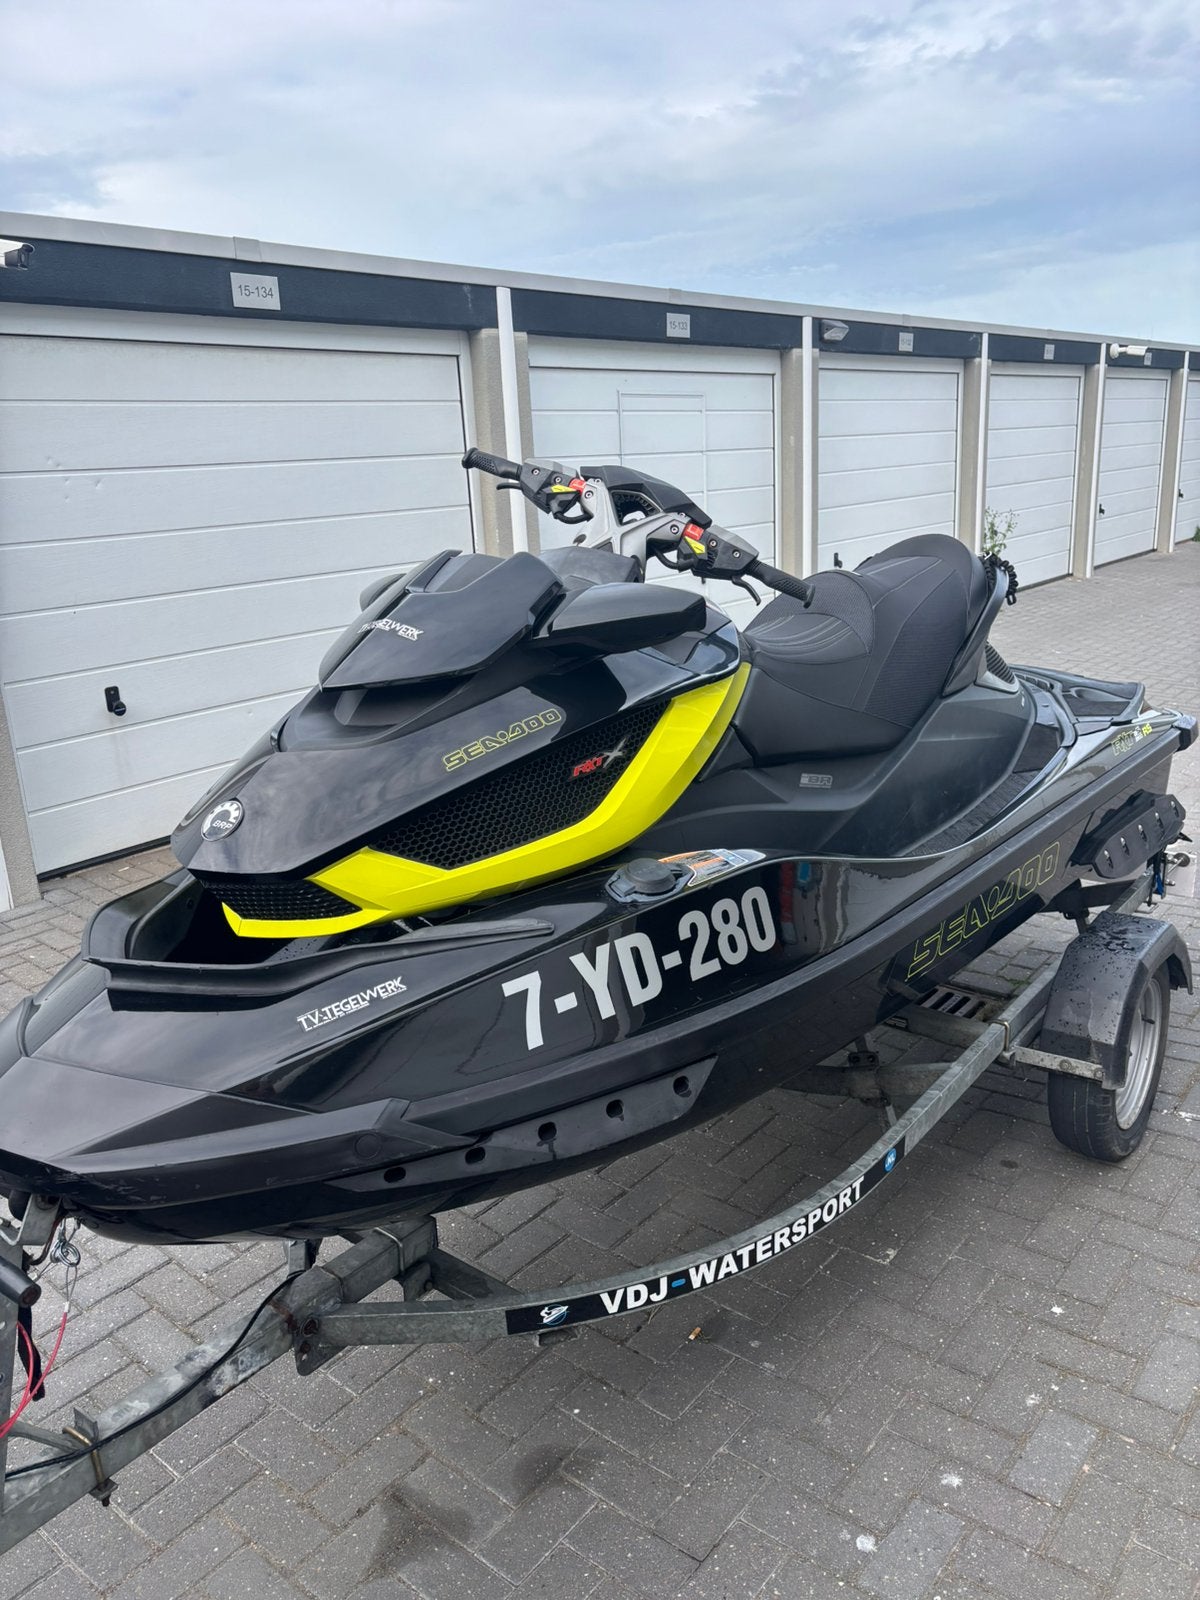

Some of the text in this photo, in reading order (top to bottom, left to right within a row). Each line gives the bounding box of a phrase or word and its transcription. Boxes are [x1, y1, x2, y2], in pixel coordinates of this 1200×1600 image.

[238, 284, 274, 298] 15-134
[212, 819, 234, 830] BRP
[501, 886, 777, 1051] 7-YD-280
